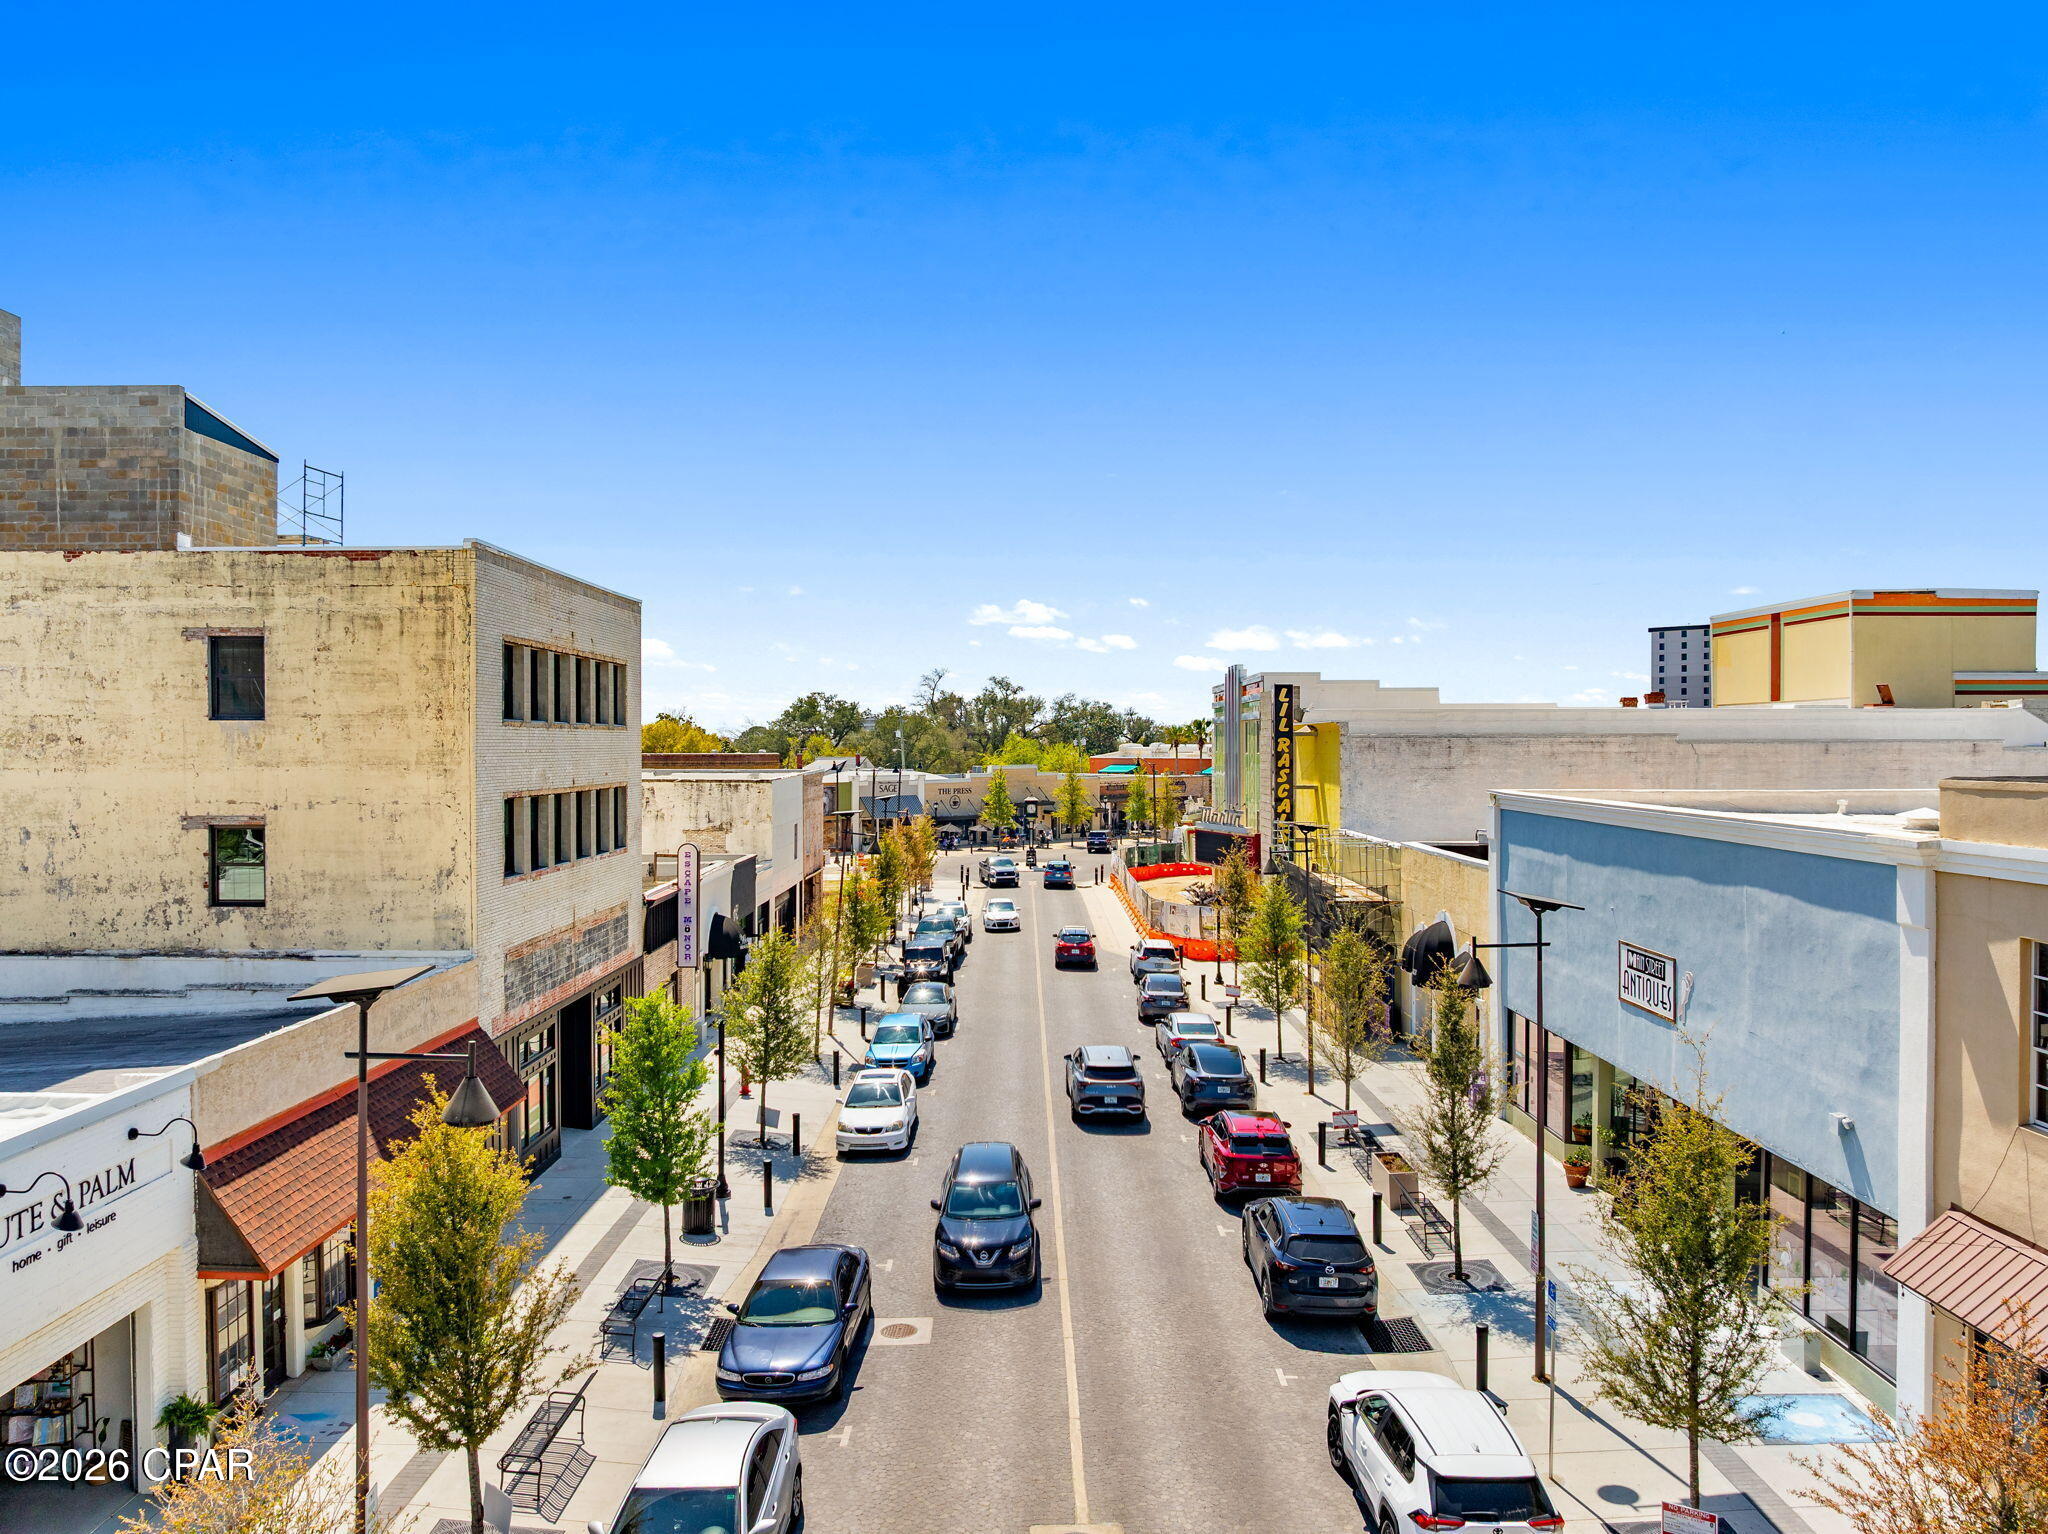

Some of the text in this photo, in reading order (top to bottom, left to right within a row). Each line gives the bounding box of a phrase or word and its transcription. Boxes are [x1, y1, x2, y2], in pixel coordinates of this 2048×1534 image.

[1278, 688, 1291, 732] LIL
[879, 784, 898, 793] SAGE
[1622, 970, 1672, 1012] ANTIQUES
[78, 1158, 136, 1209] PALM
[12, 1212, 117, 1273] home gift leisure
[1668, 1503, 1679, 1511] NO
[1680, 1507, 1710, 1519] PARKING
